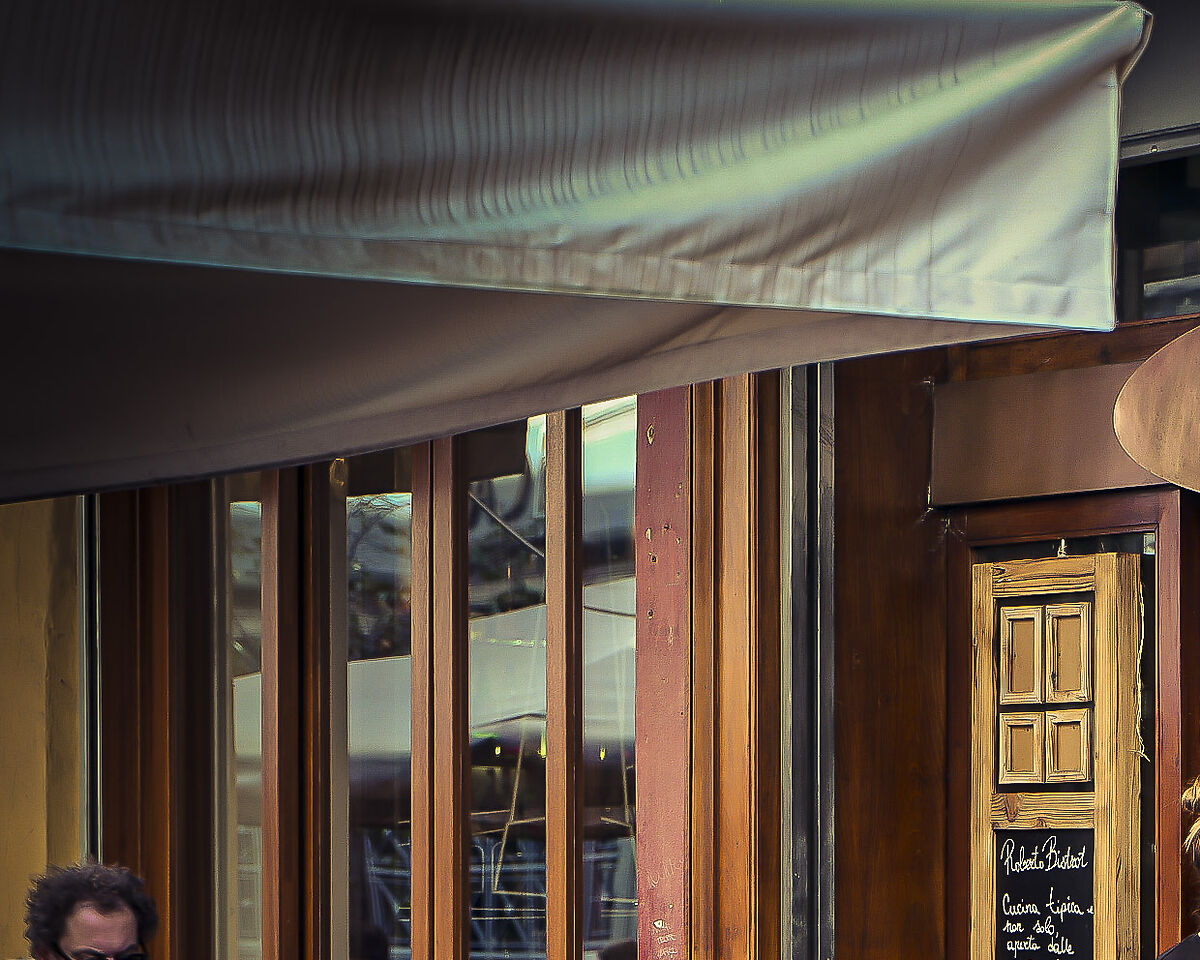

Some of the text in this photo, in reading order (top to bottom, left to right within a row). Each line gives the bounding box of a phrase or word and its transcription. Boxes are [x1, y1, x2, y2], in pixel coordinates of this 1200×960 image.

[1000, 838, 1044, 876] Roberto
[1002, 892, 1041, 916] Cucina
[1047, 936, 1075, 955] dalle
